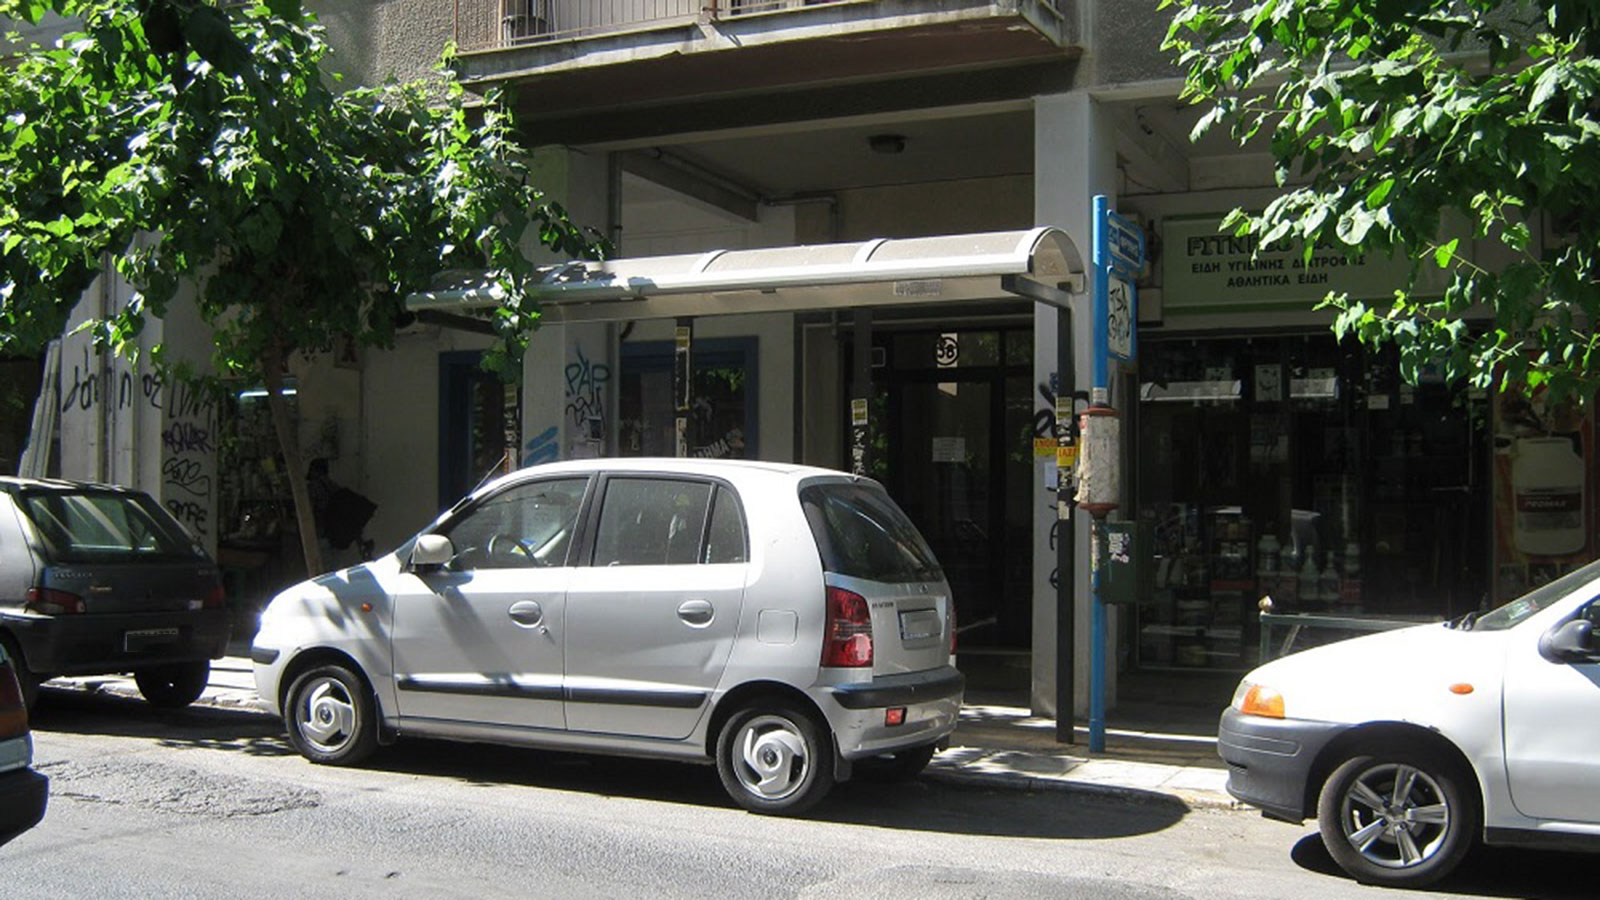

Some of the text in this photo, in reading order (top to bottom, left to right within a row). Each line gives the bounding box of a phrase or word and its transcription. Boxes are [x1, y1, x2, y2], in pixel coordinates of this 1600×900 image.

[1192, 261, 1221, 274] ΕΙΔΗ
[1227, 272, 1329, 288] ΑΘΛΗΤΙΚΑ ΕΙΔΗ
